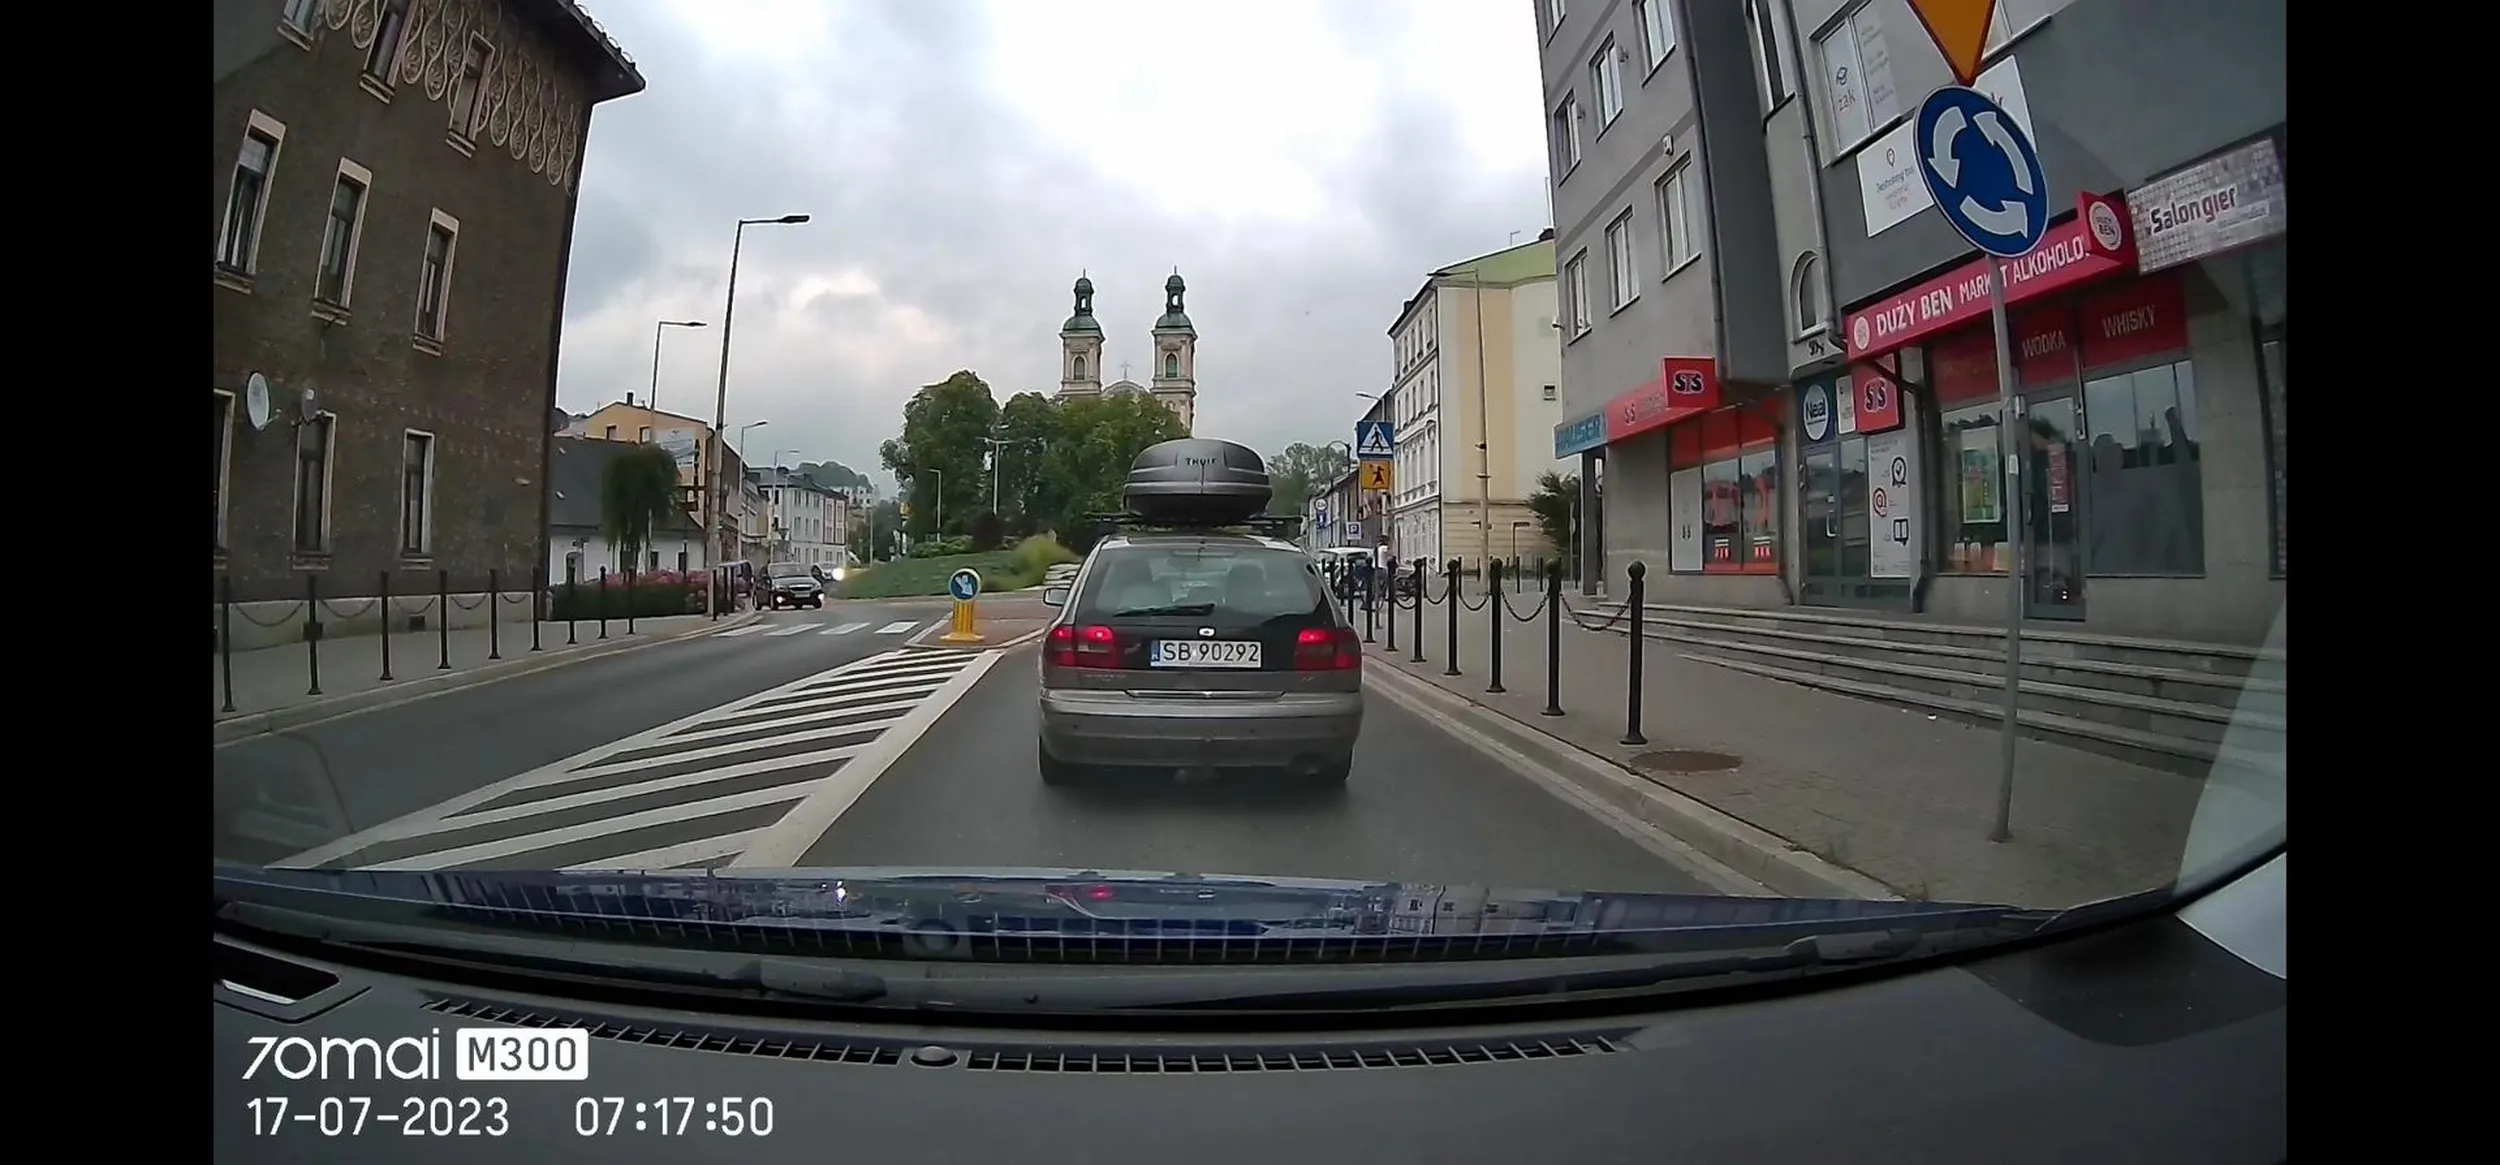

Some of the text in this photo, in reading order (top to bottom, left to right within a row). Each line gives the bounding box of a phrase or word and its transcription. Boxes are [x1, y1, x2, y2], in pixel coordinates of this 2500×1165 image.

[2150, 200, 2202, 234] Salon
[2201, 187, 2237, 224] gier
[1876, 299, 1917, 337] DUŻY
[1920, 286, 1954, 320] BEN
[1959, 265, 2008, 305] MARKT
[2102, 304, 2156, 339] WHISKY
[1163, 642, 1259, 662] SB 90292
